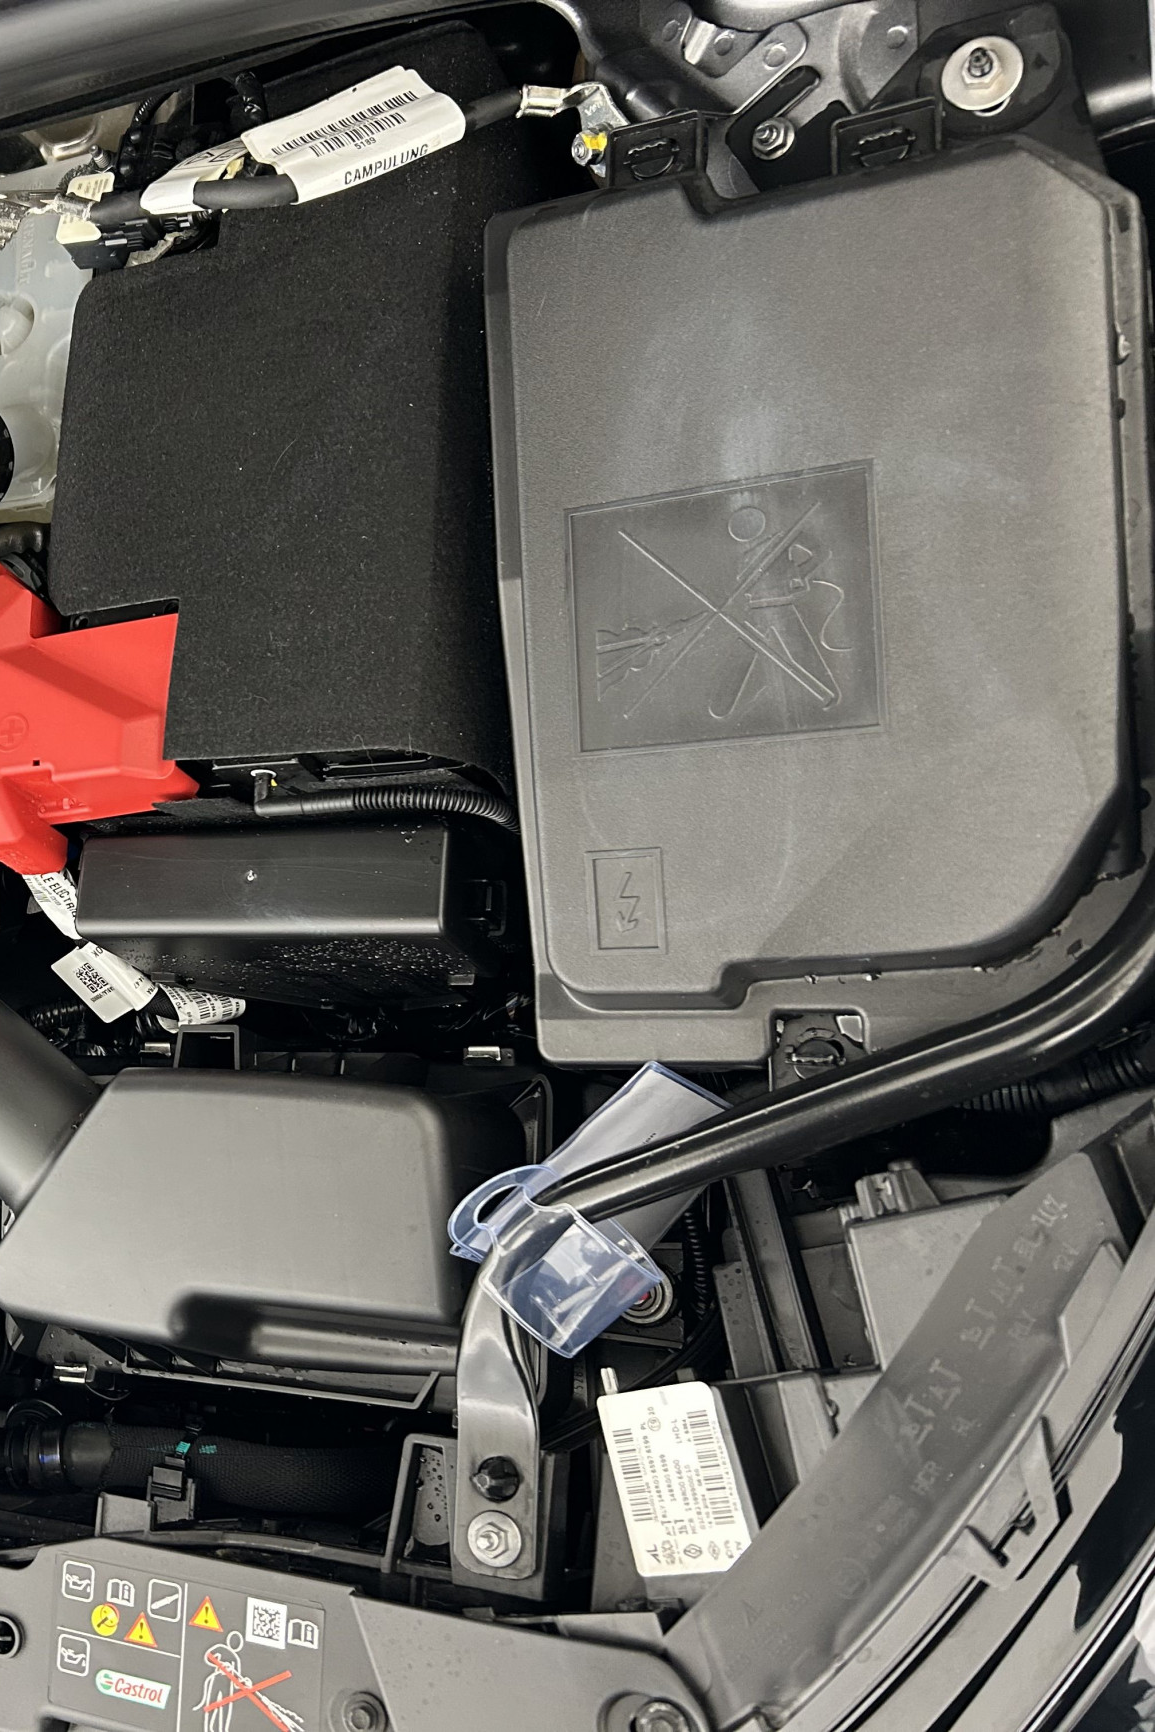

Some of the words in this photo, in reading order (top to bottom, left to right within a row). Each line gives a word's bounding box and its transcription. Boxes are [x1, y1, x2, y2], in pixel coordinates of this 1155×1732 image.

[354, 136, 377, 150] 5189
[344, 143, 429, 185] CAMPULUNG
[114, 1678, 163, 1703] Castrol
